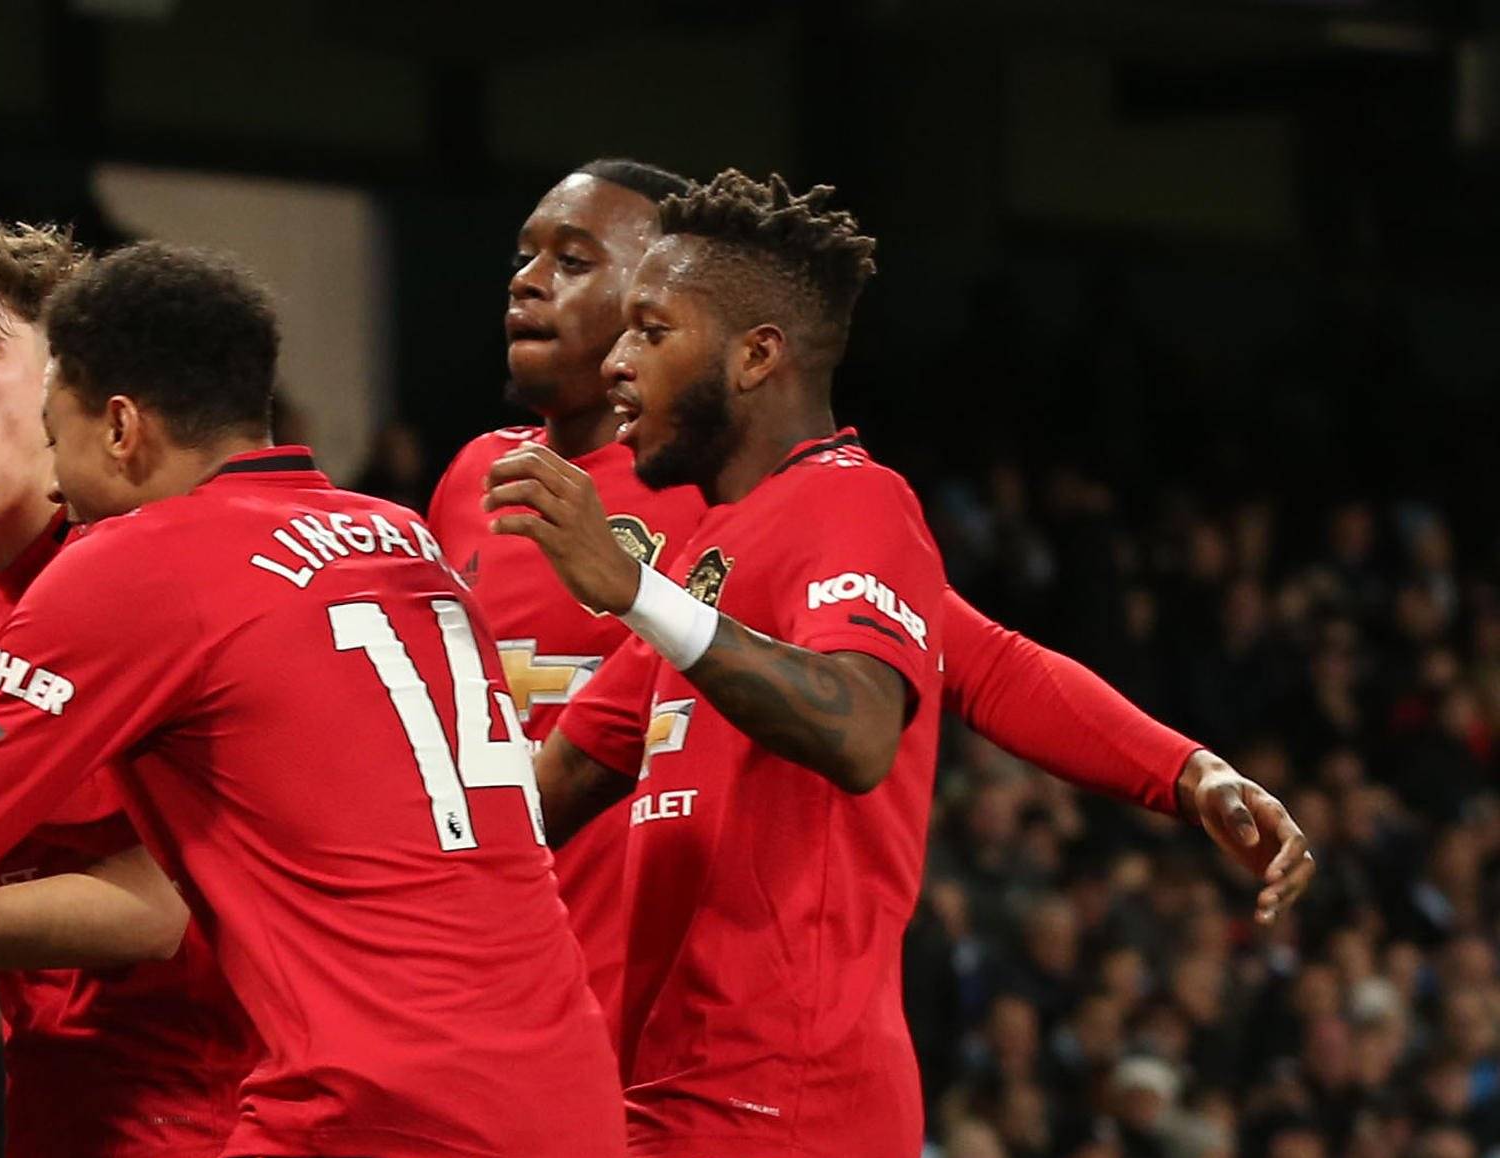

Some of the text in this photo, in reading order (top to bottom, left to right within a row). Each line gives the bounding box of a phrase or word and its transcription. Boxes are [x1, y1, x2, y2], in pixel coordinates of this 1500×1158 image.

[251, 512, 471, 591] LINGAR
[807, 571, 928, 651] KOHLER
[327, 599, 547, 851] 14
